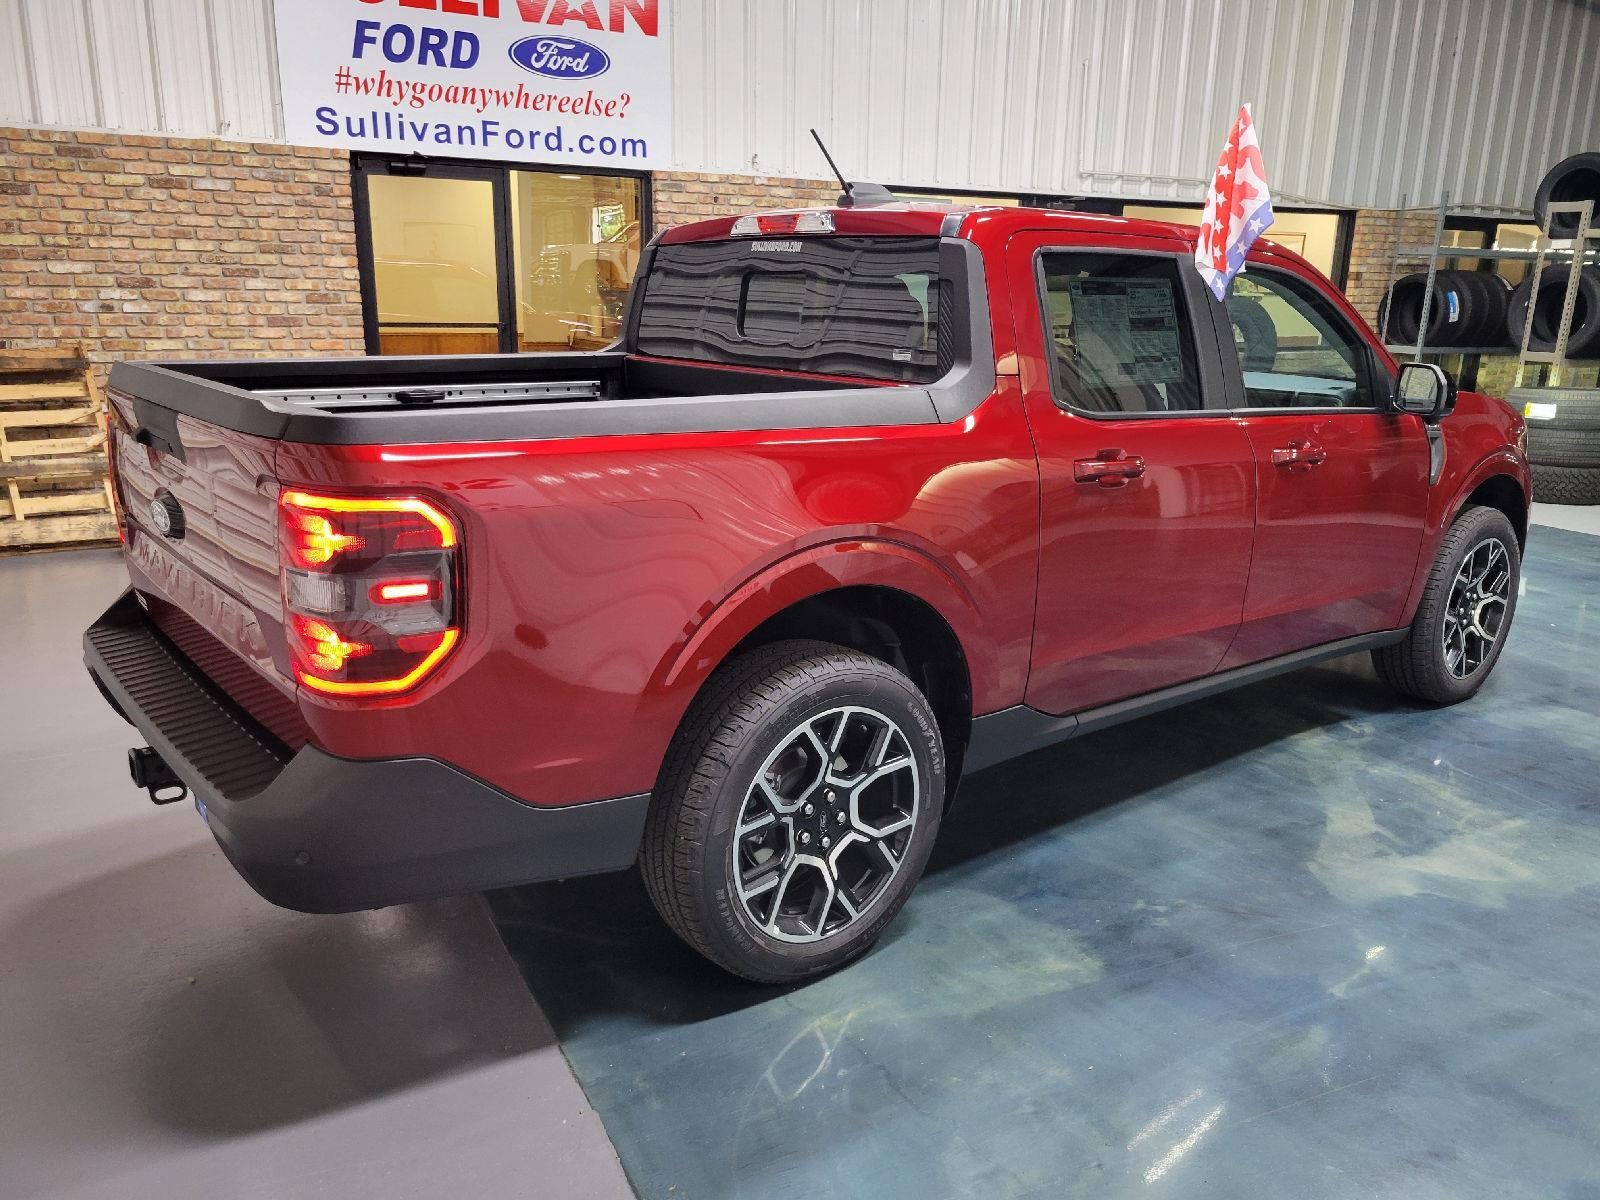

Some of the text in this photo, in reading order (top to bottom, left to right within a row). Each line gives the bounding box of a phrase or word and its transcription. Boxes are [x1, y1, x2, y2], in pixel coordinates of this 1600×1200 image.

[352, 20, 479, 69] FORD
[531, 39, 590, 72] Ford
[335, 66, 631, 118] #whygoanywhereelse?
[315, 106, 647, 158] SullivanFord.com
